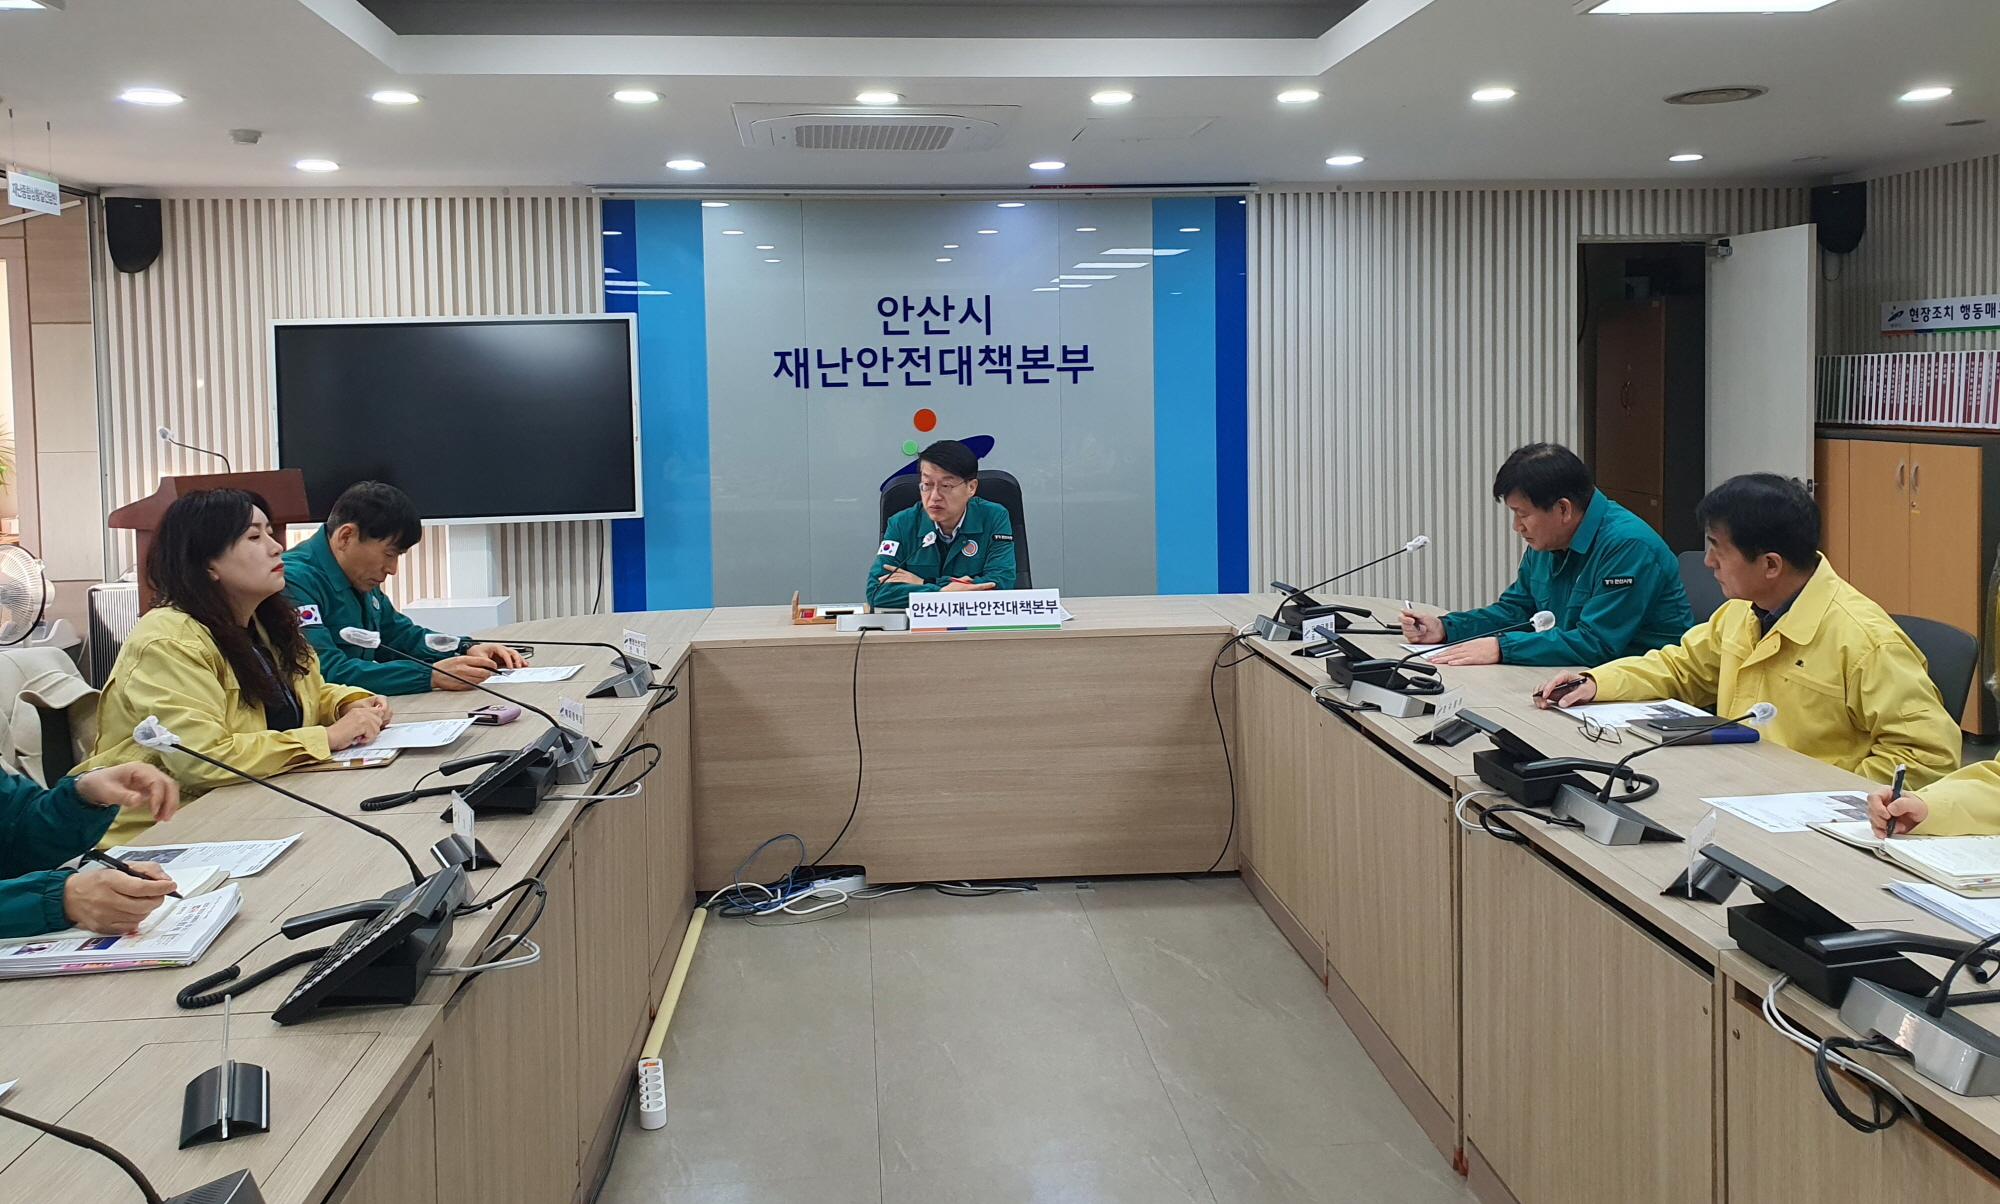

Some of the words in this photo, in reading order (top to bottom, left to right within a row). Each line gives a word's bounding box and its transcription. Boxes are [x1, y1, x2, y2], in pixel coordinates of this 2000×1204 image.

[876, 294, 991, 336] 안산시
[1909, 305, 1954, 323] 현장조치
[1960, 301, 2000, 321] 행동매
[772, 344, 1095, 389] 재난안전대책본부
[911, 600, 1059, 618] 안산시재난안전대책본부
